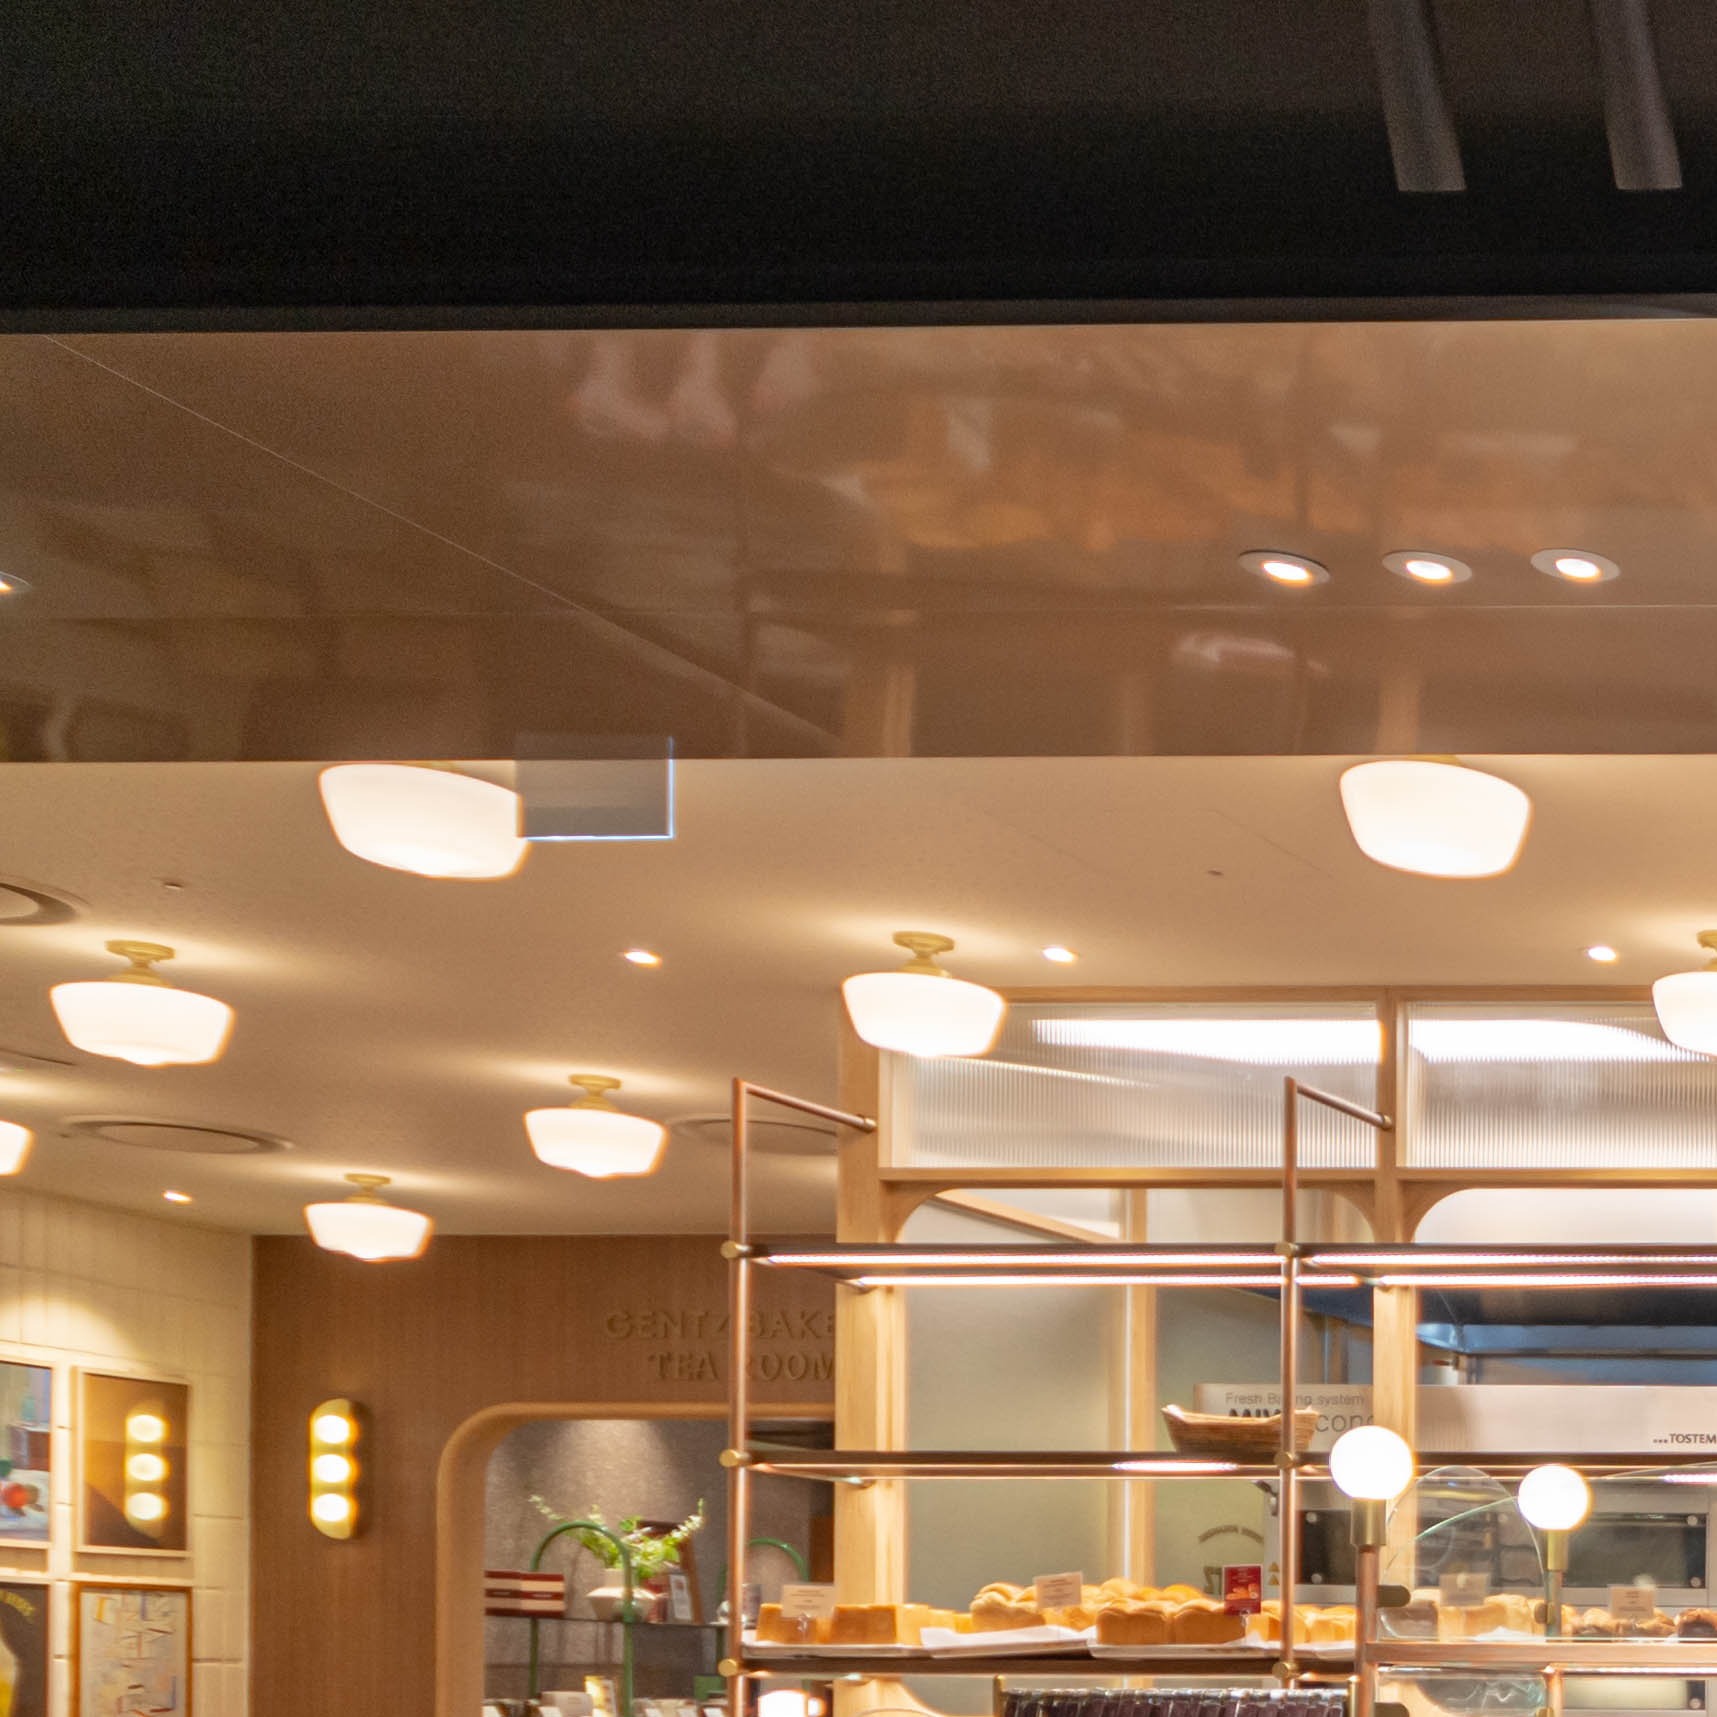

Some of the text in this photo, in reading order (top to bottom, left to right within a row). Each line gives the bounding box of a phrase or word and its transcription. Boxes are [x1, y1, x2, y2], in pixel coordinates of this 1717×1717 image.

[649, 1351, 836, 1382] TEA OOM
[1225, 1391, 1263, 1405] Fresh
[1319, 1392, 1365, 1408] system
